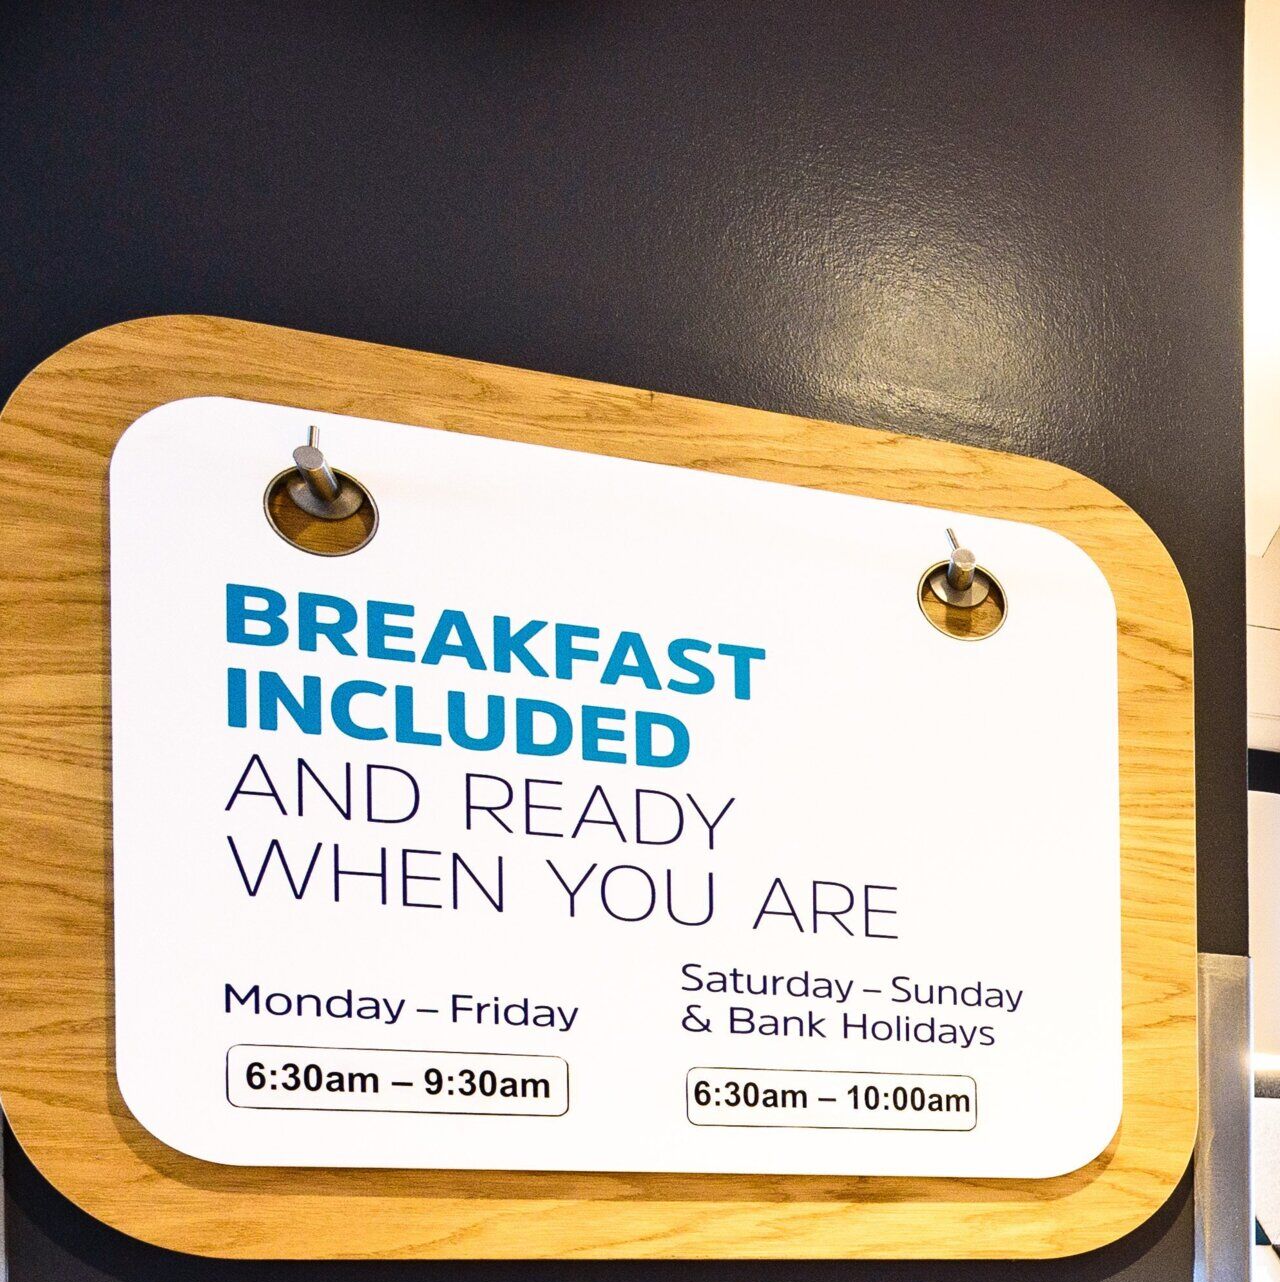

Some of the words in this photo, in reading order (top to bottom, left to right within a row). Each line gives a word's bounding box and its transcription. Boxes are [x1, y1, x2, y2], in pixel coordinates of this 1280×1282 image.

[225, 582, 766, 701] BREAKFAST
[227, 667, 691, 769] INCLUDED
[224, 753, 420, 824] AND
[465, 772, 736, 850] READY
[226, 835, 504, 913] WHEN
[545, 859, 714, 927] YOU
[752, 877, 899, 940] ARE
[224, 983, 406, 1025] Monday
[451, 994, 579, 1032] Friday
[681, 963, 854, 1004] Saturday
[891, 976, 1023, 1013] Sunday
[681, 1004, 713, 1033] &
[729, 1006, 827, 1038] Bank
[843, 1012, 995, 1049] Holidays
[245, 1061, 379, 1094] 6:30am
[424, 1067, 550, 1099] 9:30am
[694, 1080, 808, 1110] 6:30am
[847, 1084, 970, 1113] 10:00am
